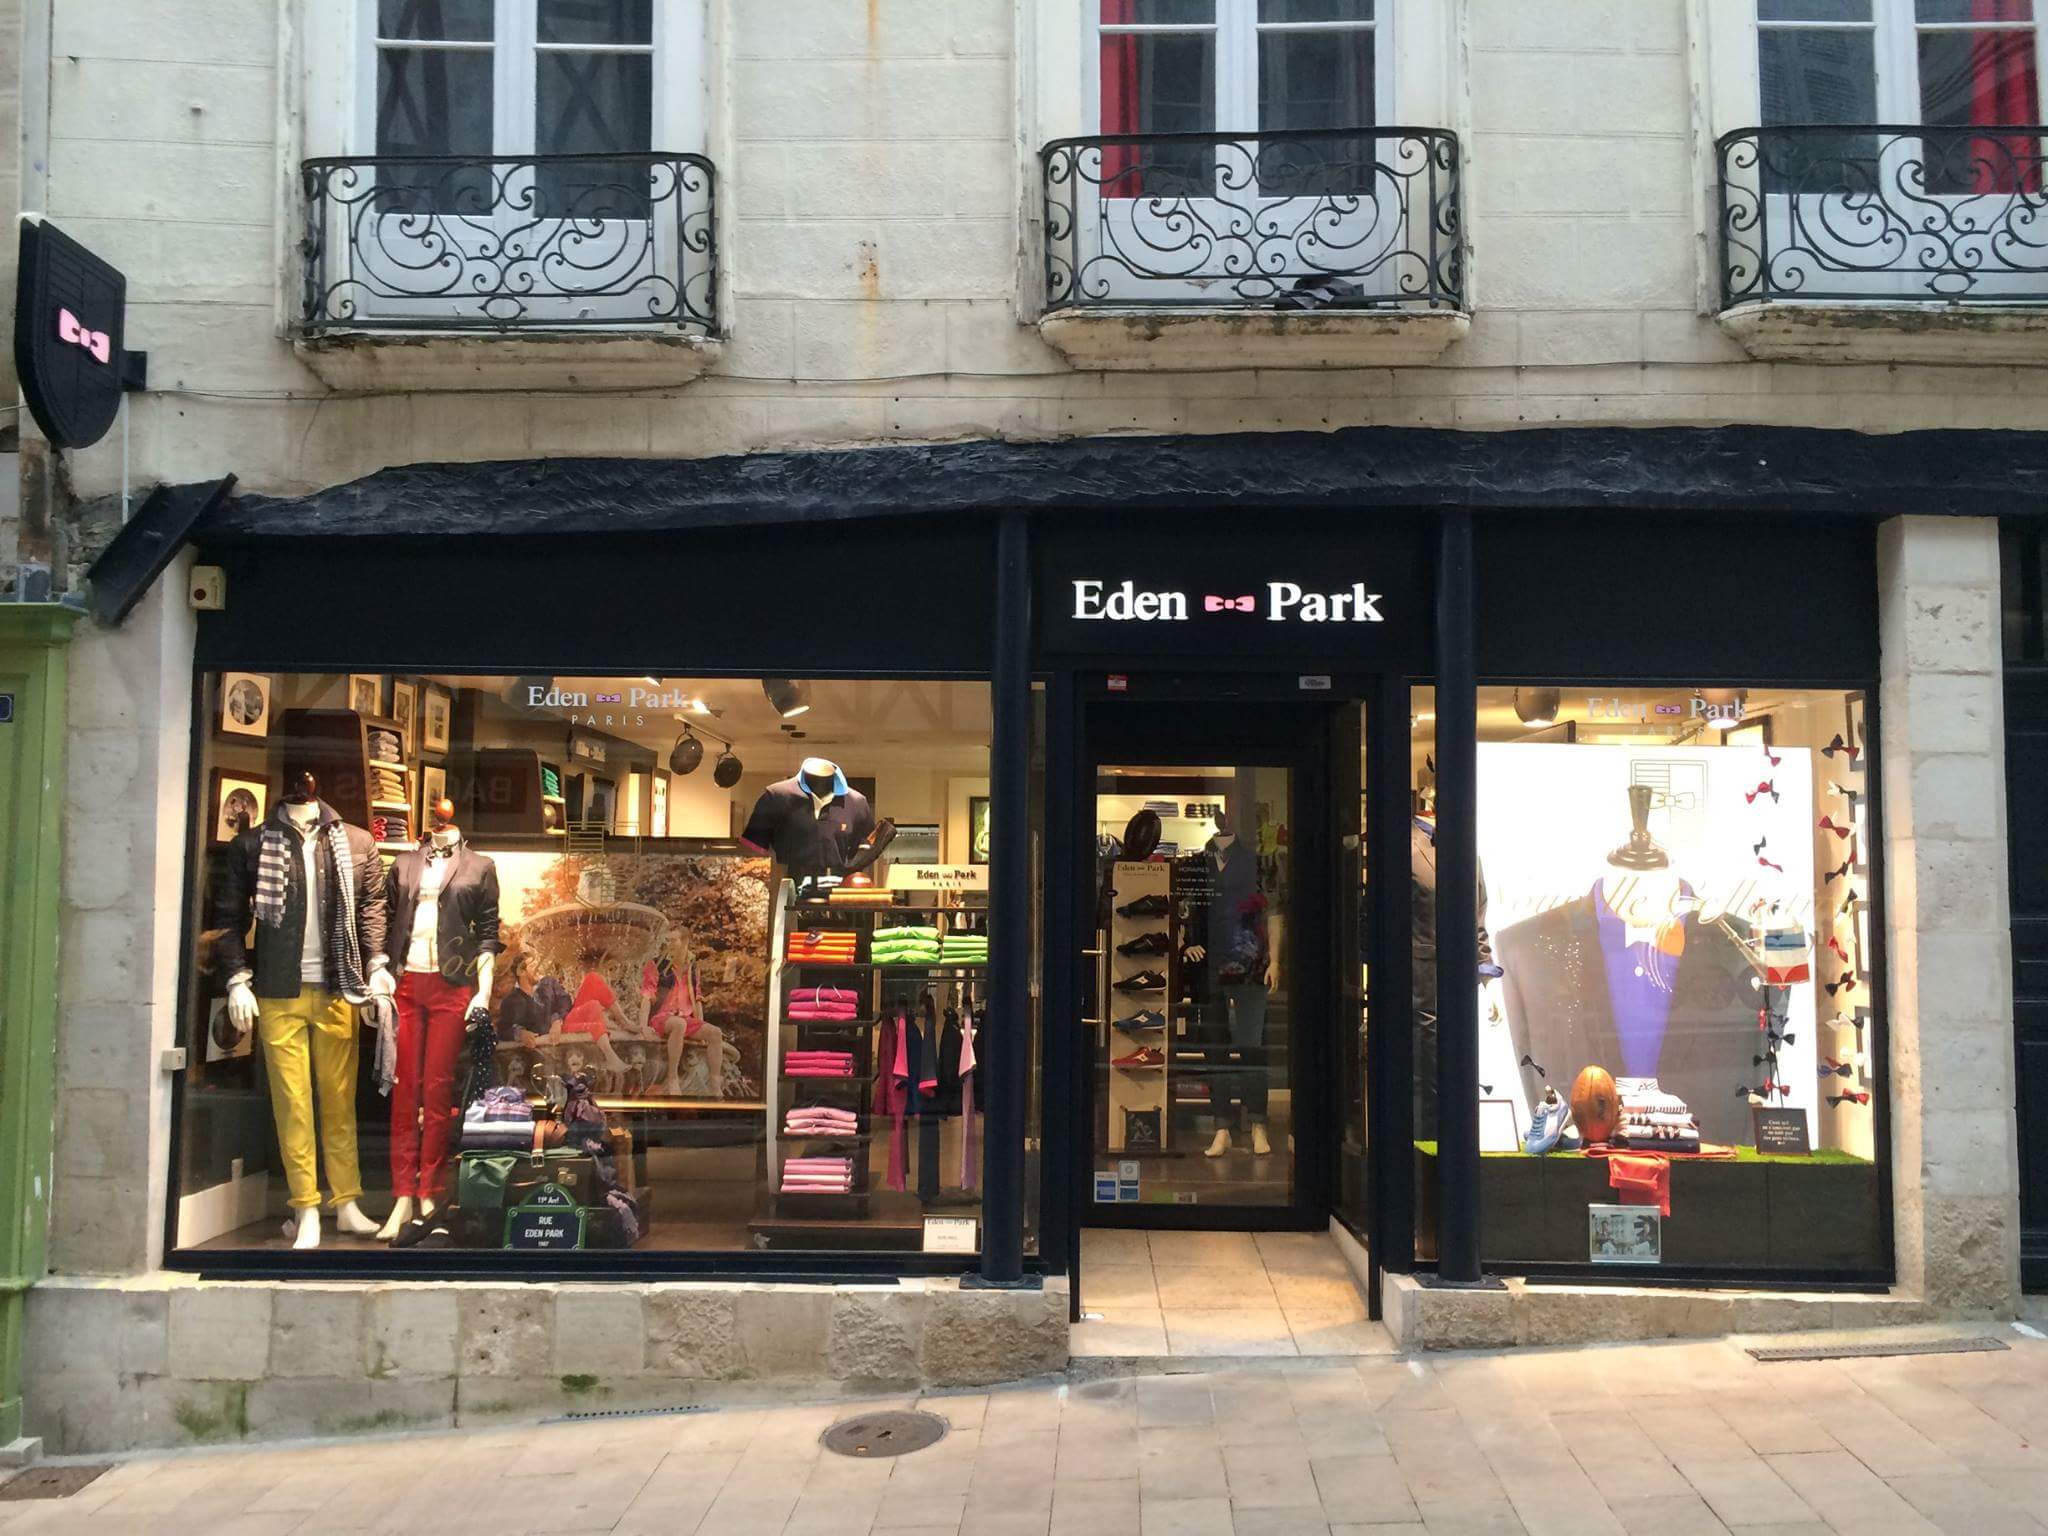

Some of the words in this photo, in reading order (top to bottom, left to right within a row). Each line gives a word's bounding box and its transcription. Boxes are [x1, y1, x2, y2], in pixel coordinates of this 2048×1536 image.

[1072, 580, 1189, 621] Eden
[1266, 582, 1385, 622] Park
[527, 686, 588, 707] Eden
[629, 688, 689, 708] Park
[1586, 697, 1647, 719] Eden
[1688, 697, 1745, 720] Park
[571, 714, 645, 727] PARIS
[916, 869, 940, 880] Eden
[954, 869, 977, 880] Park
[538, 1216, 552, 1225] RUE
[525, 1229, 543, 1237] EDEN
[545, 1229, 564, 1237] PARK
